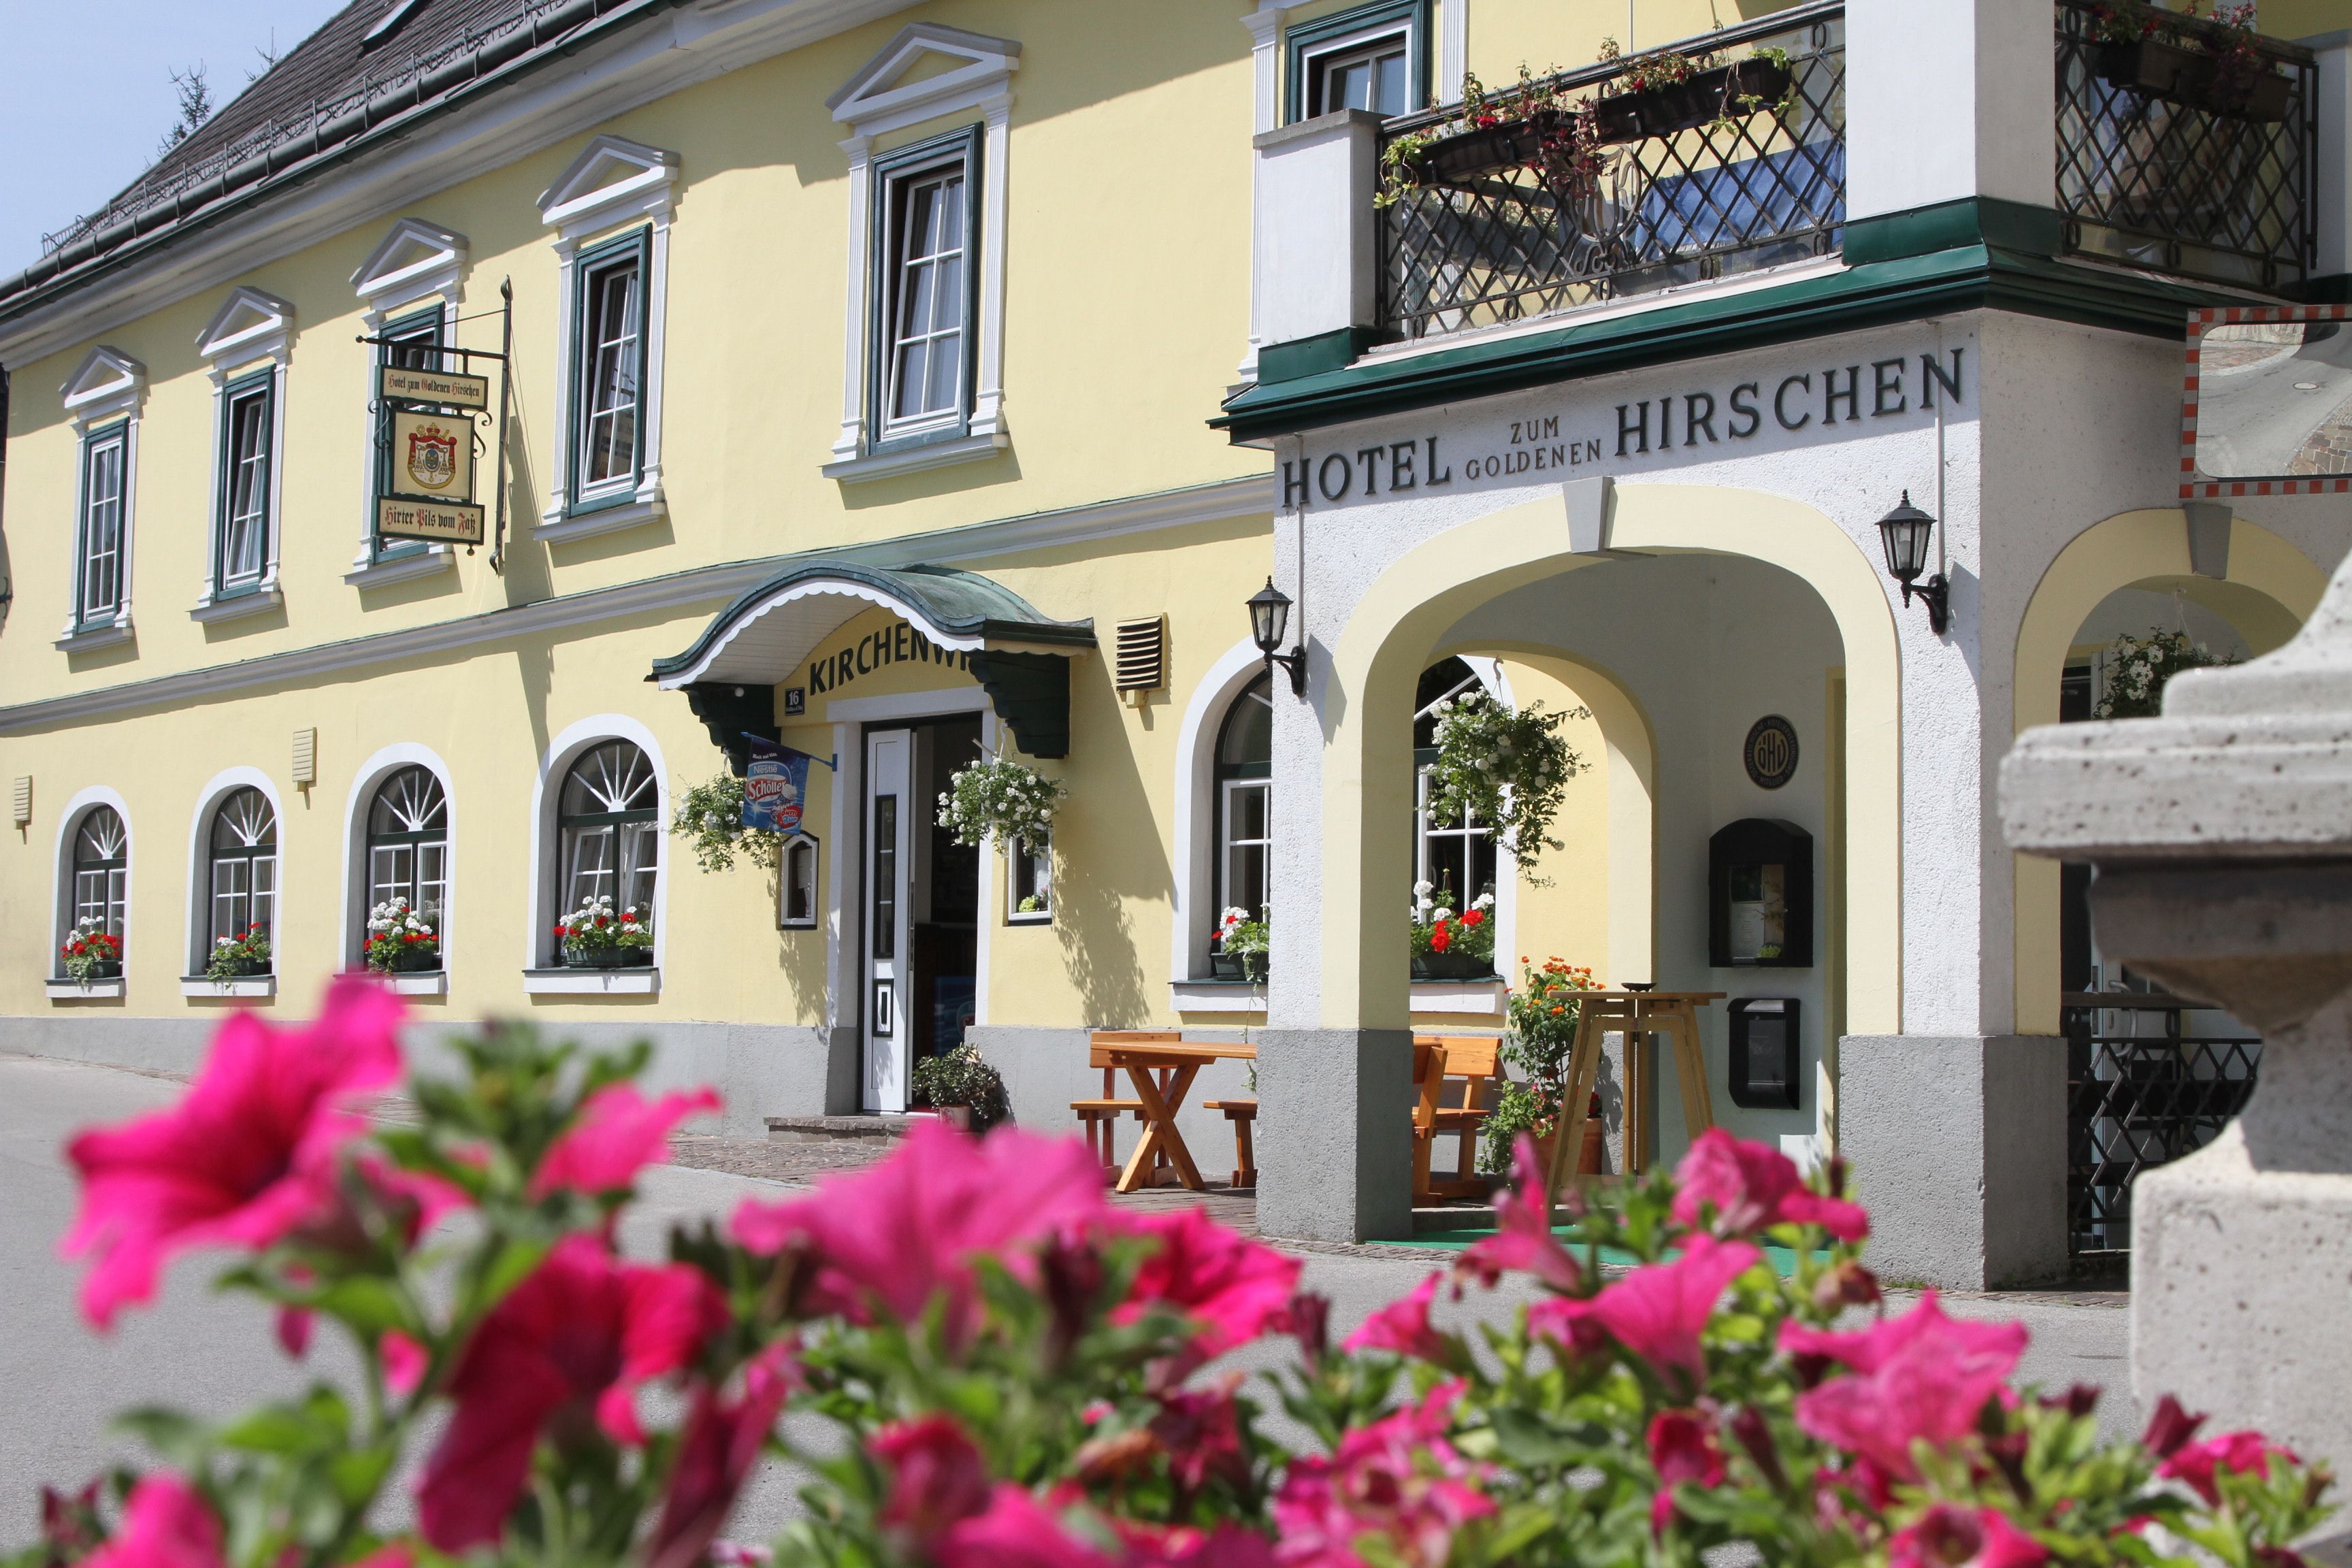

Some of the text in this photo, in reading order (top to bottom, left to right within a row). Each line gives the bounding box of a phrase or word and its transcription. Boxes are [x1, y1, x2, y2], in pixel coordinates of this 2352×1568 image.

[389, 374, 479, 398] Hotel zum Goldenen Hirschen
[1614, 348, 1963, 456] HIRSCHEN
[1510, 416, 1559, 444] ZUM
[1282, 436, 1451, 508] HOTEL
[1465, 439, 1601, 480] GOLDENEN
[385, 506, 476, 535] Hirter Pils vom Faß
[789, 691, 799, 706] 16
[1758, 732, 1786, 772] ÖHV
[753, 765, 778, 774] Nestlé
[749, 779, 786, 800] Schöller
